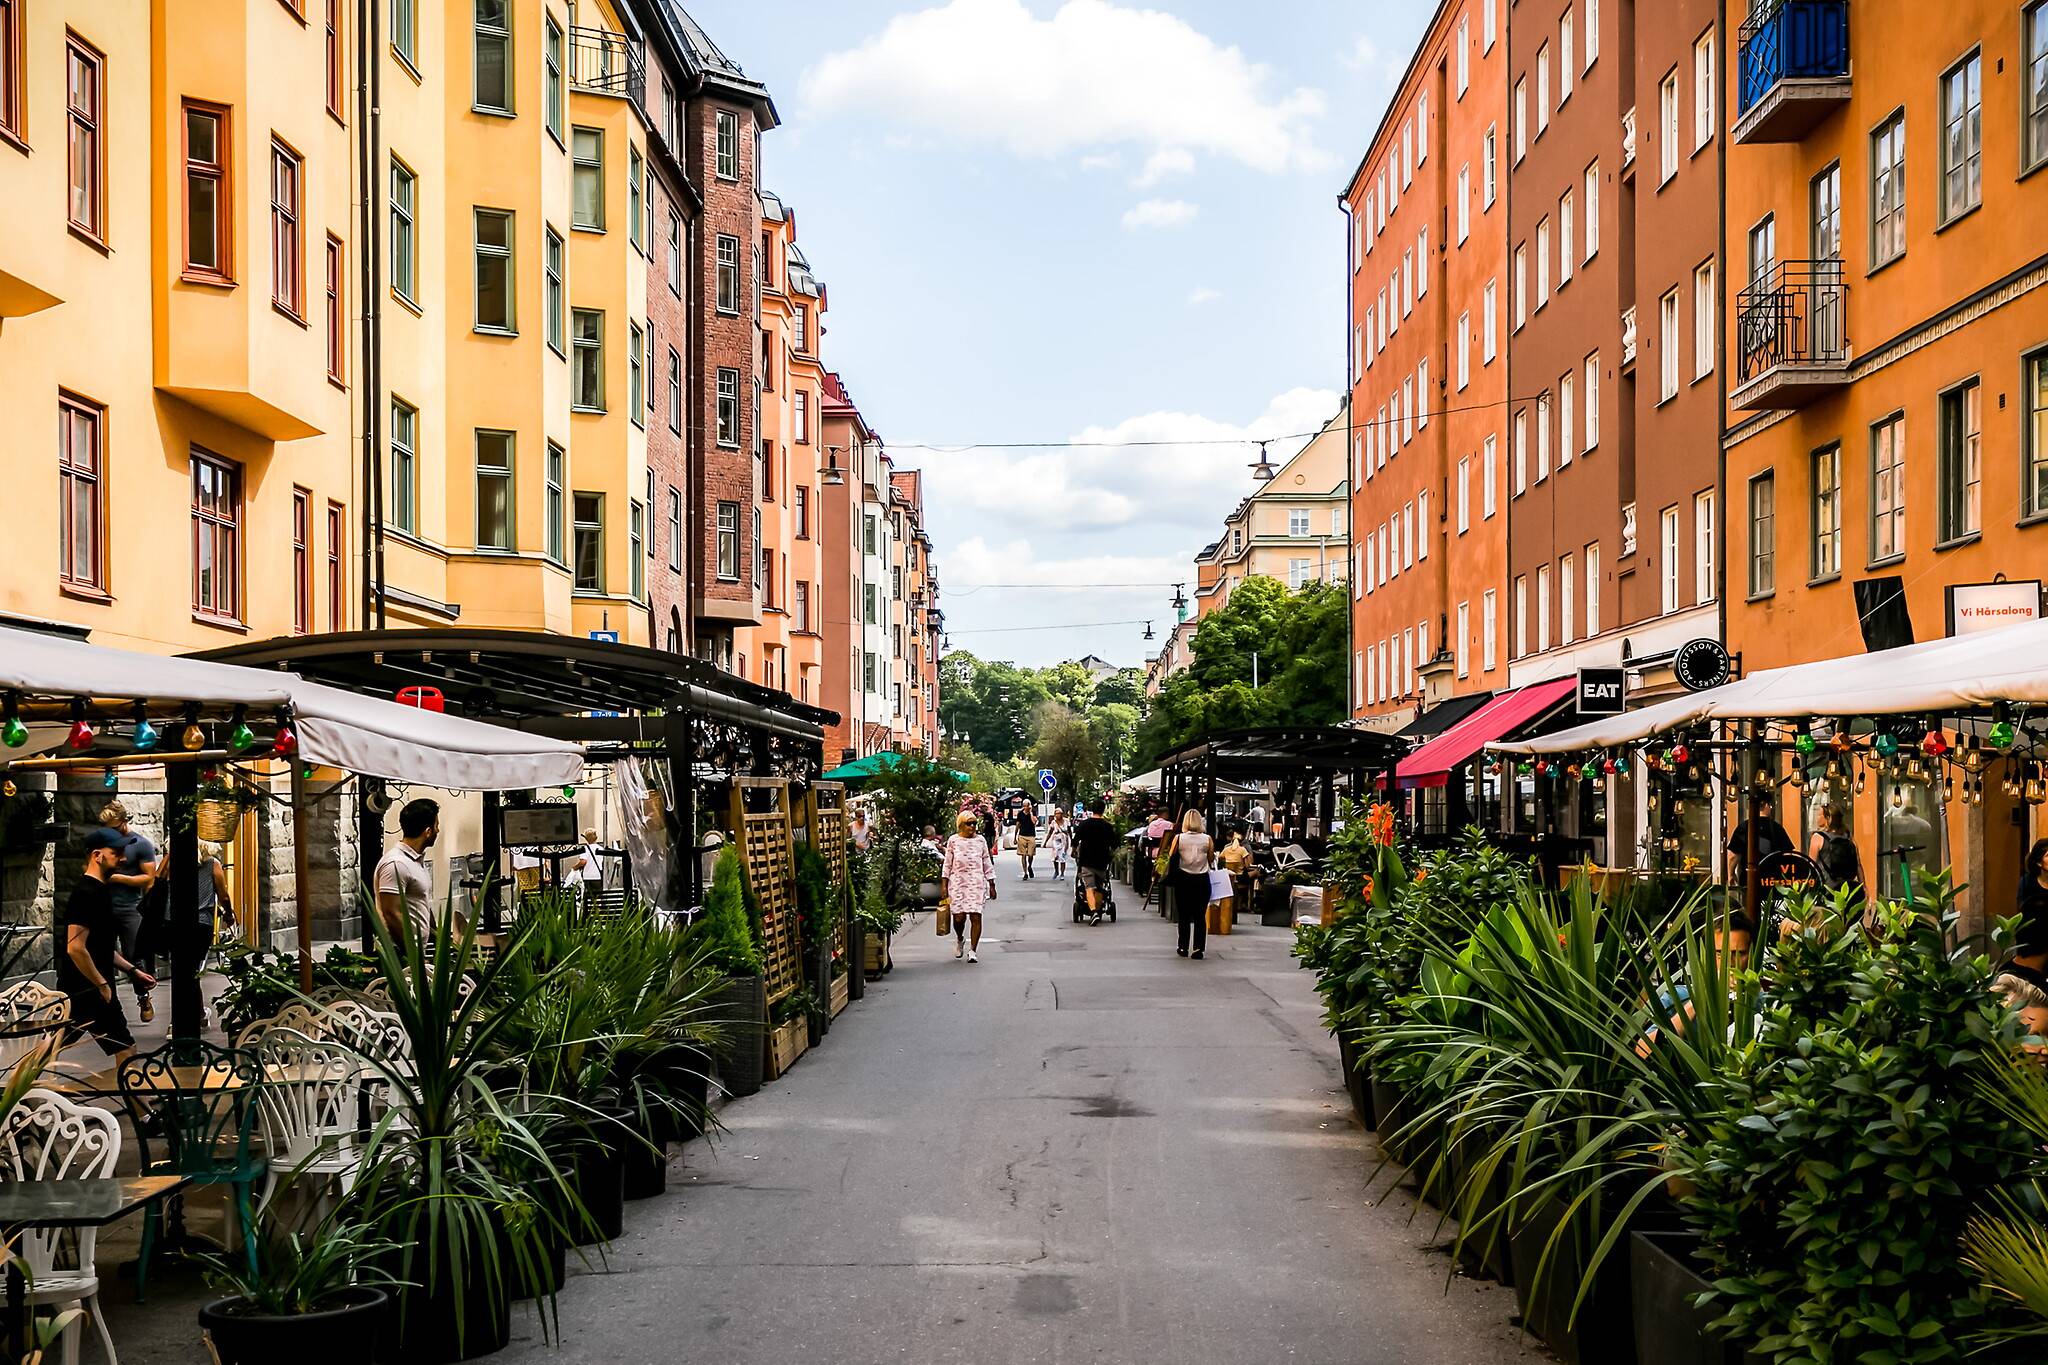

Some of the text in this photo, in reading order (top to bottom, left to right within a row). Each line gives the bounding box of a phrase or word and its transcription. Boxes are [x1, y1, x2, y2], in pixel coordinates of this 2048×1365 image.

[1961, 605, 2033, 617] Vi Hårsalong
[1681, 643, 1712, 680] ADOLFSSON
[1698, 654, 1726, 687] PARTNERS
[1584, 683, 1620, 698] EAT
